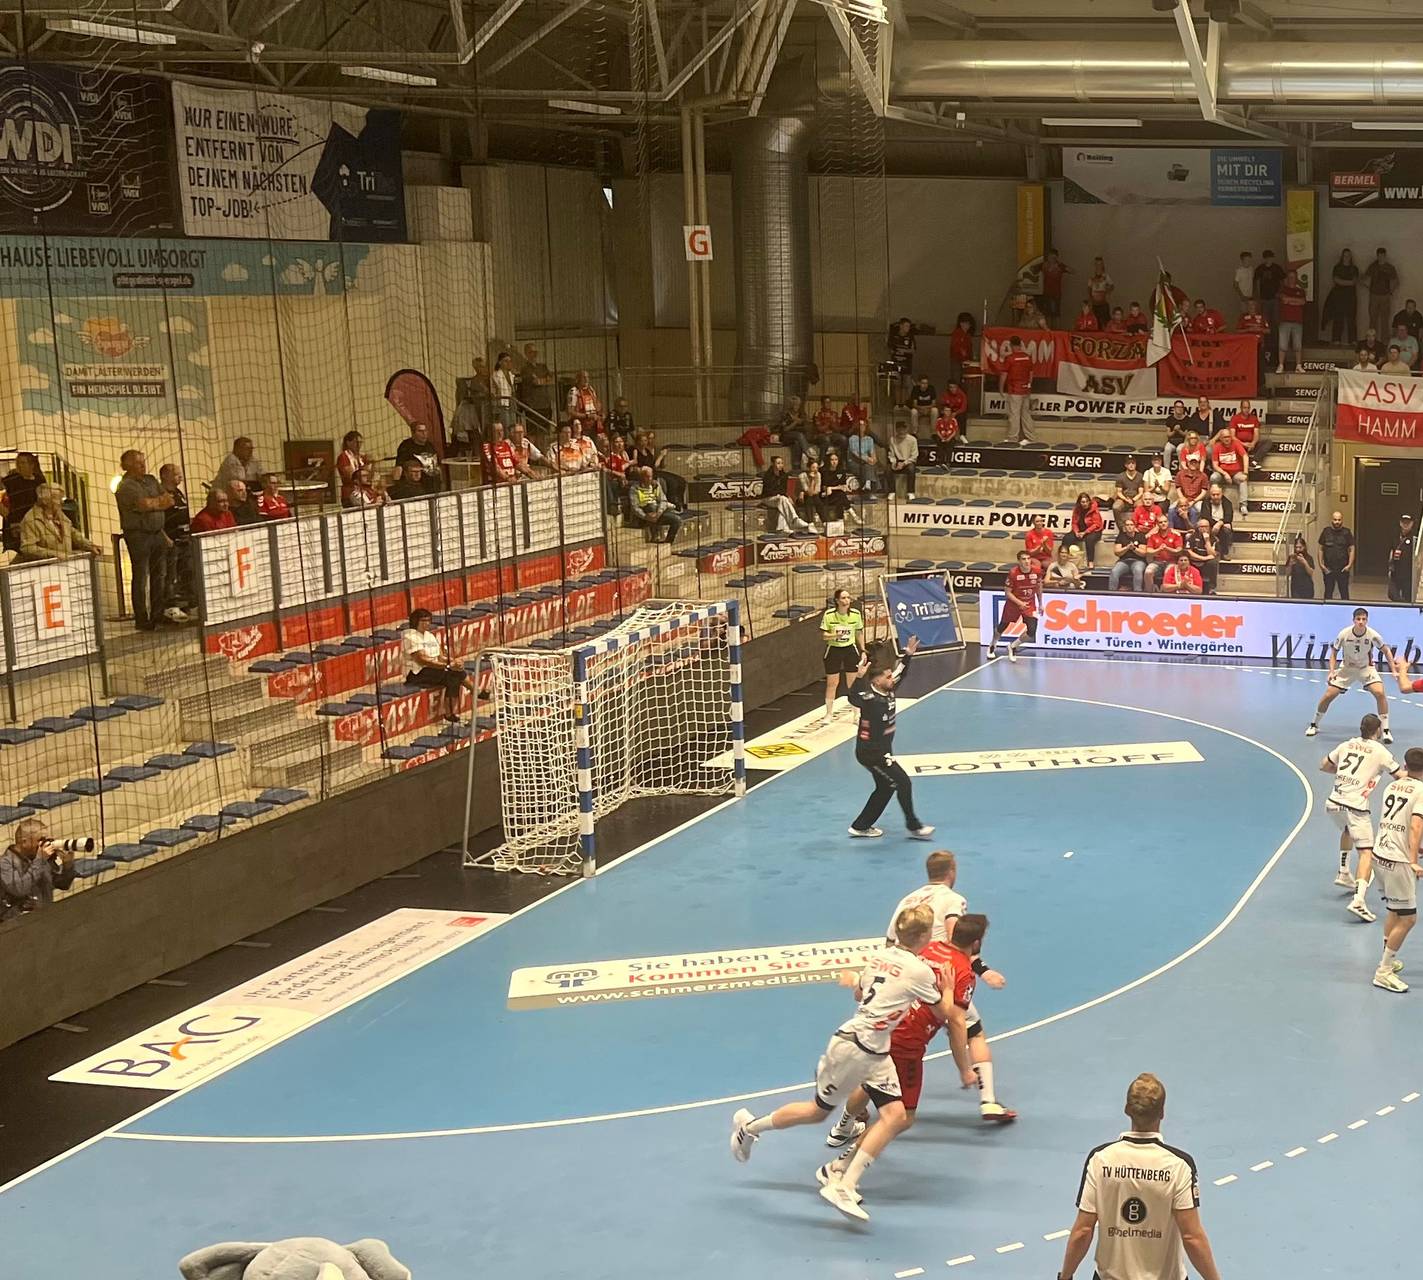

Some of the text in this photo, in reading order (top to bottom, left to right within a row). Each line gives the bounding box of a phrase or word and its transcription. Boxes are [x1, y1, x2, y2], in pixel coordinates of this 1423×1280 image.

[184, 106, 212, 130] NUR
[216, 109, 256, 133] EINEN
[186, 136, 284, 164] ENTFERNT VON
[188, 166, 238, 190] DEINEM
[1216, 163, 1268, 177] MIT DIR
[1334, 175, 1377, 185] BERMEL
[190, 196, 254, 219] TOP-JOB!
[688, 229, 710, 256] G
[0, 246, 207, 269] HAUSE LIEBEVOLL UMSORGT
[1070, 335, 1148, 361] FORZA
[1303, 362, 1336, 370] SENGER
[88, 385, 134, 395] HEIMSPIEL
[1081, 373, 1135, 396] ASV
[1362, 380, 1417, 405] ASV
[1064, 399, 1126, 414] POWER
[1129, 404, 1153, 416] FÜR
[1155, 405, 1176, 416] SIE
[1358, 414, 1417, 439] HAMM
[1049, 456, 1102, 469] SENGER
[903, 512, 930, 525] MIT
[932, 513, 985, 526] VOLLER
[988, 511, 1060, 529] POWER
[235, 546, 251, 589] F
[1241, 564, 1277, 573] SENGER
[42, 583, 64, 630] E
[1043, 599, 1244, 640] Schroeder
[1043, 634, 1244, 654] Fenster Türen Wintergärten
[1353, 645, 1361, 654] 3
[1347, 742, 1373, 755] SWG
[914, 752, 1176, 774] POTTHOFF
[1339, 752, 1365, 776] 51
[1390, 783, 1415, 794] SWG
[1383, 794, 1409, 821] 97
[266, 920, 434, 1000] Forderungsmanagement,
[290, 934, 426, 1001] NPL und Immobilien
[627, 957, 860, 985] Kommen Sie zu
[628, 961, 671, 973] Sie
[682, 952, 769, 967] haben
[869, 958, 903, 978] SWG
[244, 949, 345, 998] Ihr Partner für
[87, 1013, 262, 1079] BAG
[1102, 1164, 1171, 1182] TV HÜTTENBERG
